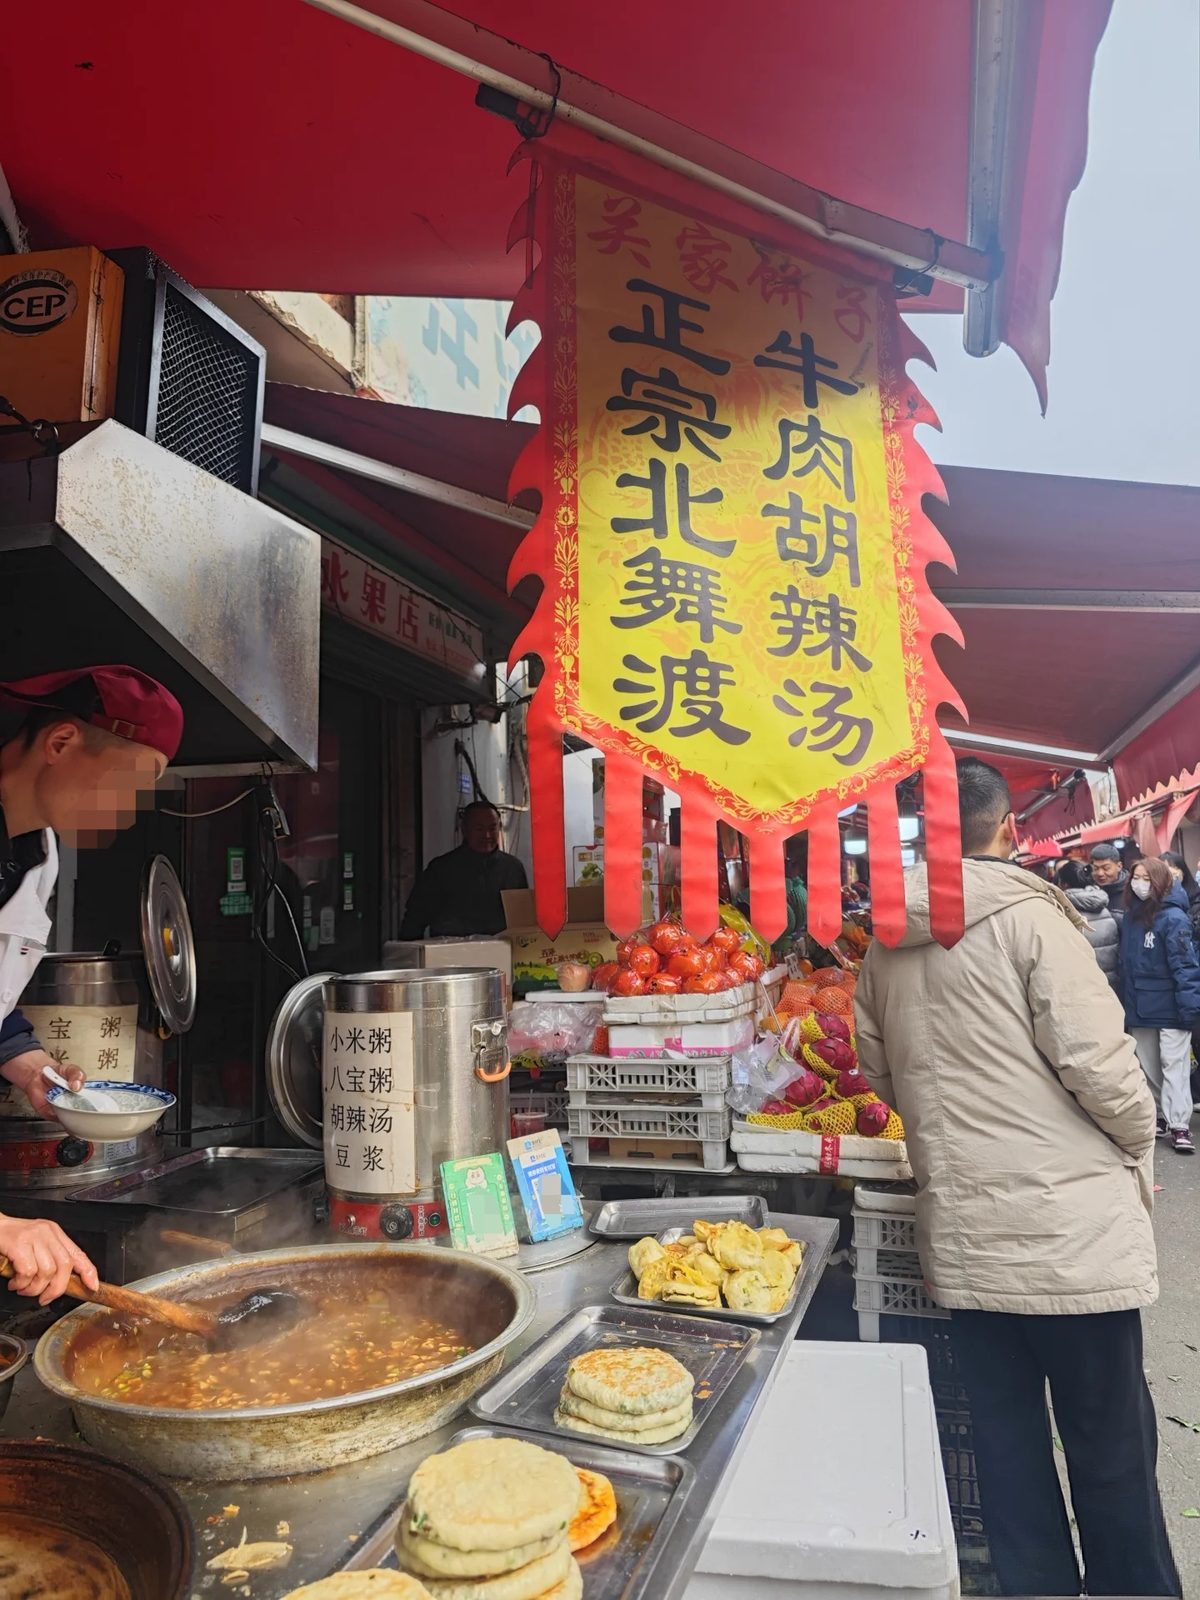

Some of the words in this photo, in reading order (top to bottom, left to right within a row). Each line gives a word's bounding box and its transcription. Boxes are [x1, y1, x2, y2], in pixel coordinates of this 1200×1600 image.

[4, 294, 66, 319] CEP
[606, 278, 751, 746] 正宗北舞渡
[753, 329, 874, 766] 牛肉胡辣汤
[321, 551, 420, 644] 水果店
[330, 1026, 392, 1054] 小米粥
[330, 1065, 393, 1094] 八宝粥
[330, 1103, 393, 1134] 胡辣汤
[335, 1143, 385, 1171] 豆浆
